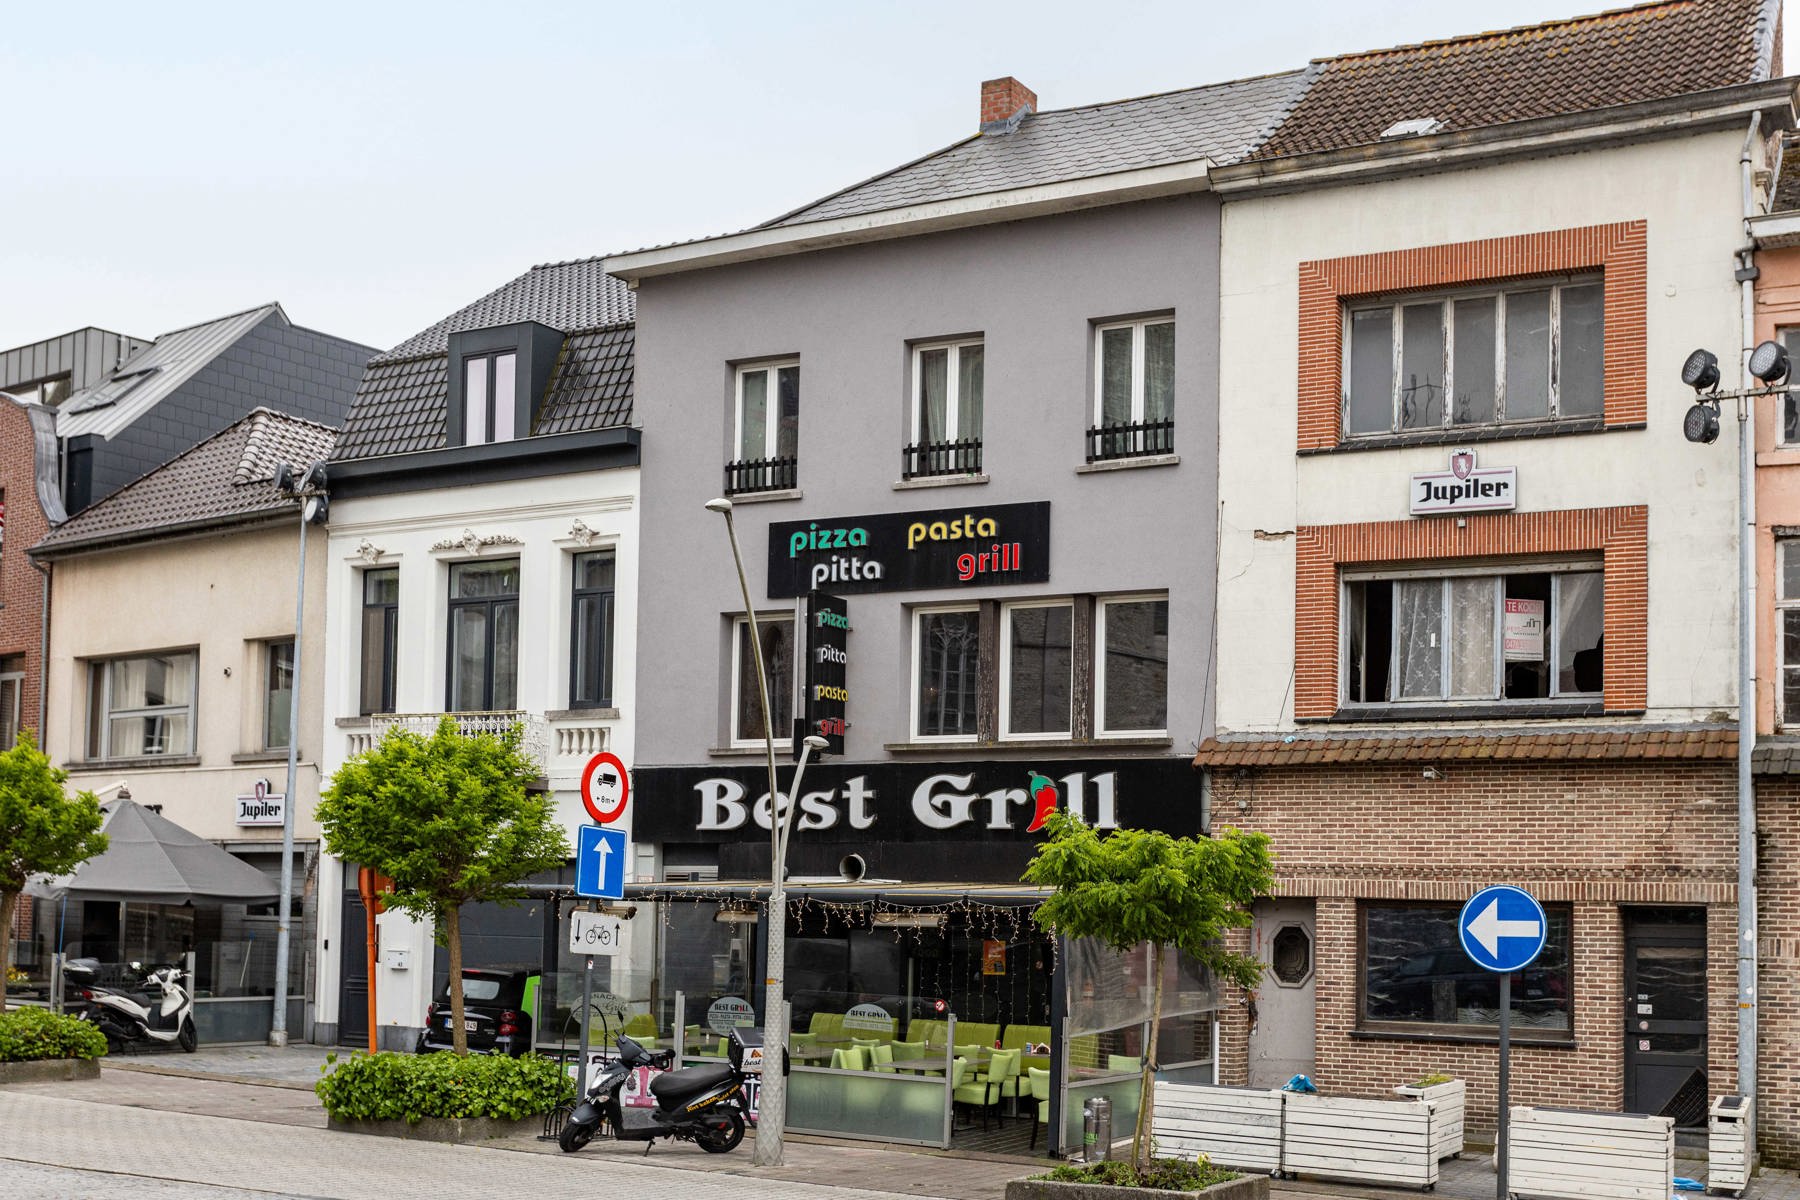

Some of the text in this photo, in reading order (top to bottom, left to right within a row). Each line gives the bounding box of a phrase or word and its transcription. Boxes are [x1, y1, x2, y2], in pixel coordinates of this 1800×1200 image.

[1418, 479, 1509, 505] Jupiler
[790, 523, 869, 558] pizza
[908, 514, 998, 550] pasta
[956, 543, 1020, 581] grill
[811, 555, 883, 590] pitta
[1507, 601, 1517, 612] TE
[818, 608, 849, 629] pizza
[819, 644, 847, 664] pitta
[817, 685, 849, 702] pasta
[819, 717, 845, 736] grill
[240, 801, 281, 820] Jupiler
[694, 770, 1119, 832] Best Grill
[714, 1003, 729, 1011] BEST
[744, 1058, 762, 1066] best
